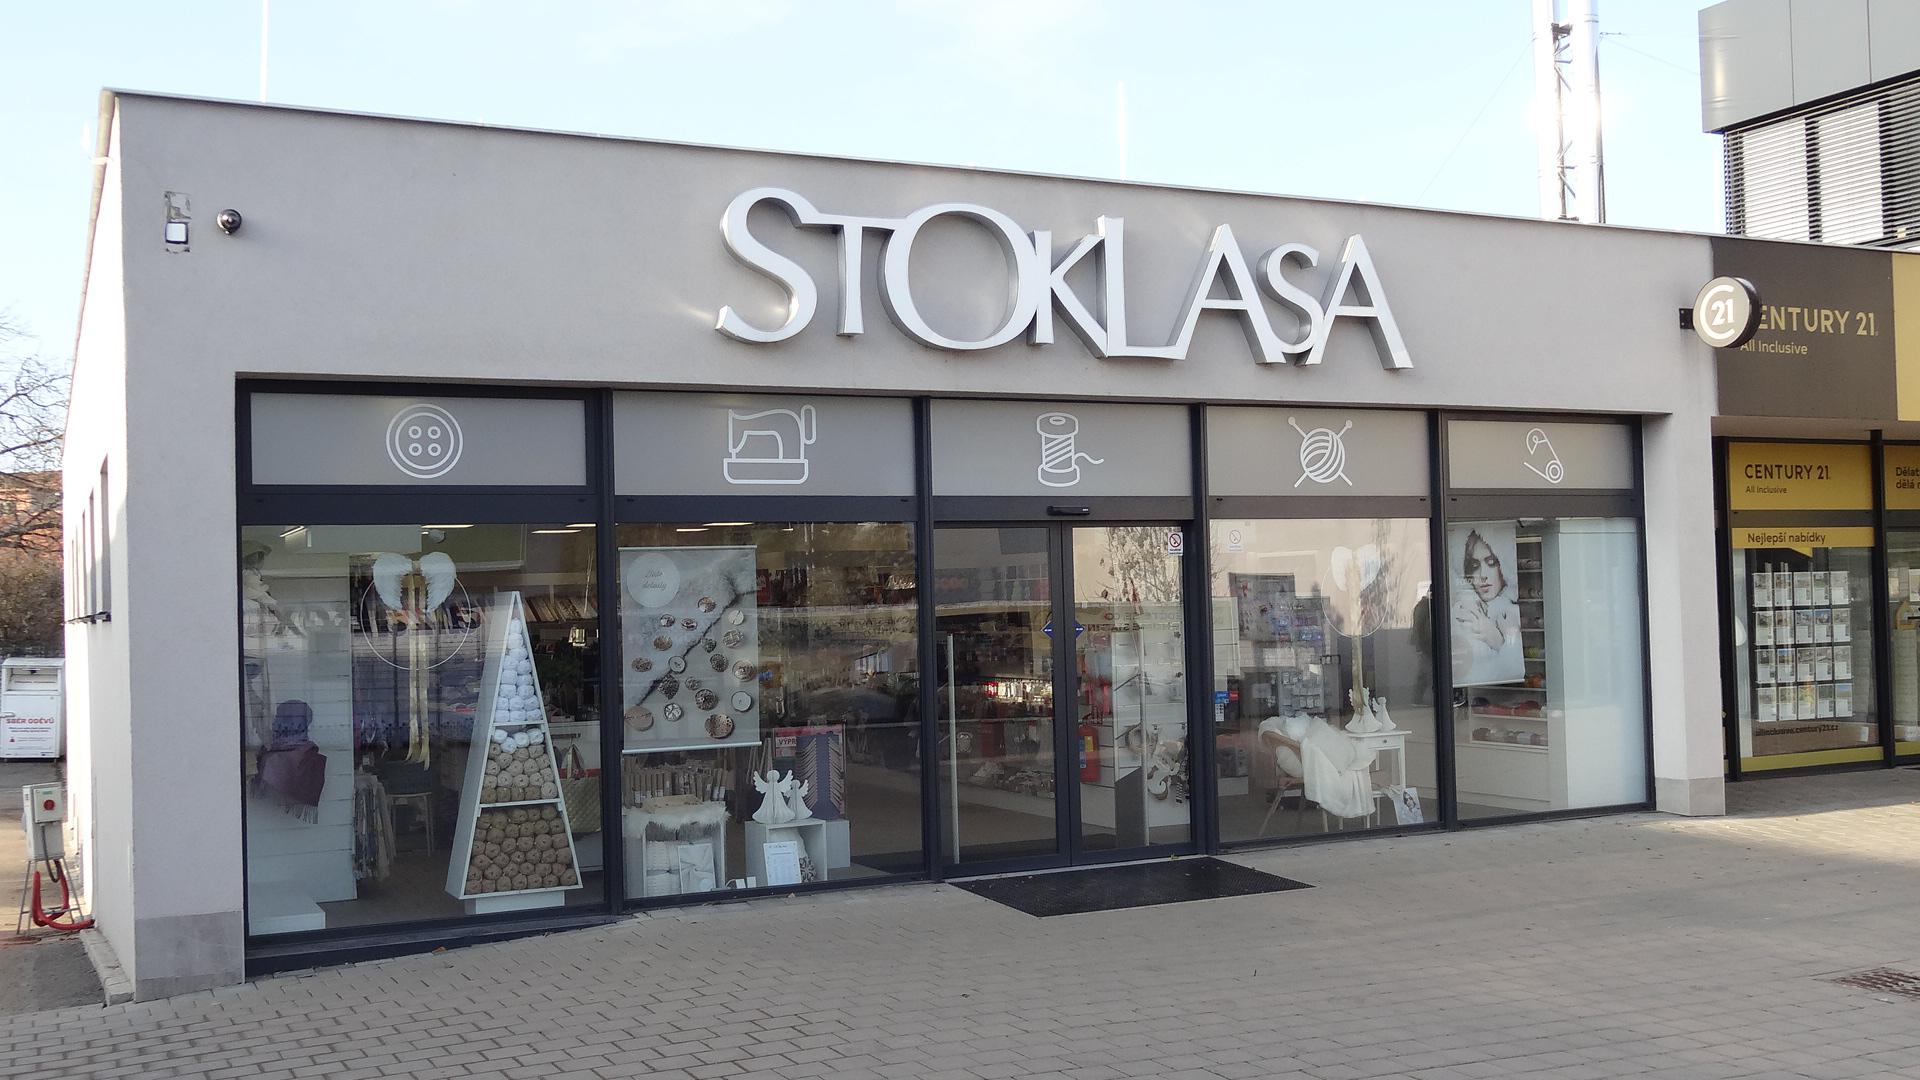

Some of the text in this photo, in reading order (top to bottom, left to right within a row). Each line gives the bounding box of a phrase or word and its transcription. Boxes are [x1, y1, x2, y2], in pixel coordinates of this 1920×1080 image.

[714, 186, 1414, 370] STOKLASA
[1711, 298, 1734, 326] 21
[1758, 305, 1849, 335] ENTURY
[1740, 338, 1808, 355] All Inclusive
[1744, 464, 1813, 479] CENTURY
[1746, 485, 1787, 495] All Inclusive
[1747, 532, 1826, 546] Nejlepší nabídky
